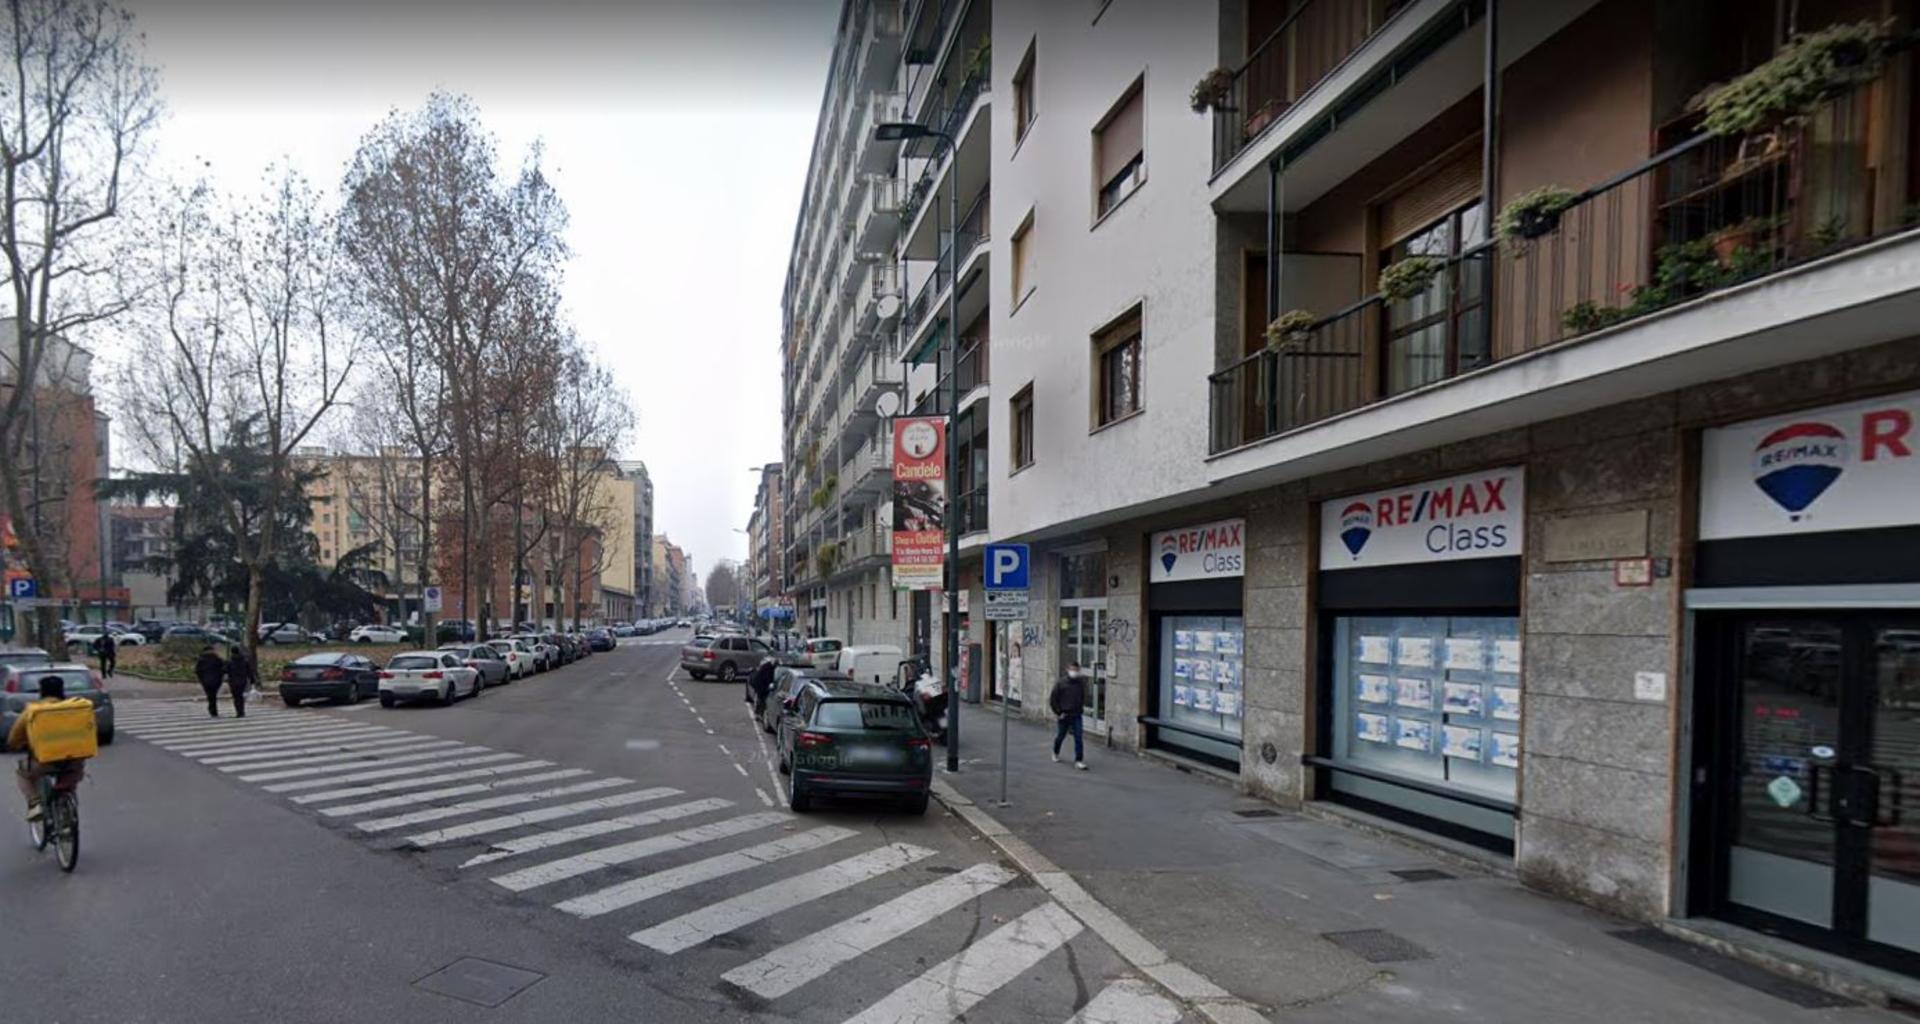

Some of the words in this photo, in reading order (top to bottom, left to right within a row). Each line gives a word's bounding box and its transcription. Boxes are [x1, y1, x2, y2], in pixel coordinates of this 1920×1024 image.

[1861, 409, 1912, 461] R
[896, 461, 941, 478] Candele
[1761, 444, 1838, 467] RE/MAX
[1376, 477, 1507, 528] RE/MAX
[1179, 525, 1241, 554] RE/MAX
[1426, 523, 1507, 553] Class
[994, 549, 1020, 585] P
[1203, 552, 1241, 573] Class
[15, 580, 30, 596] P
